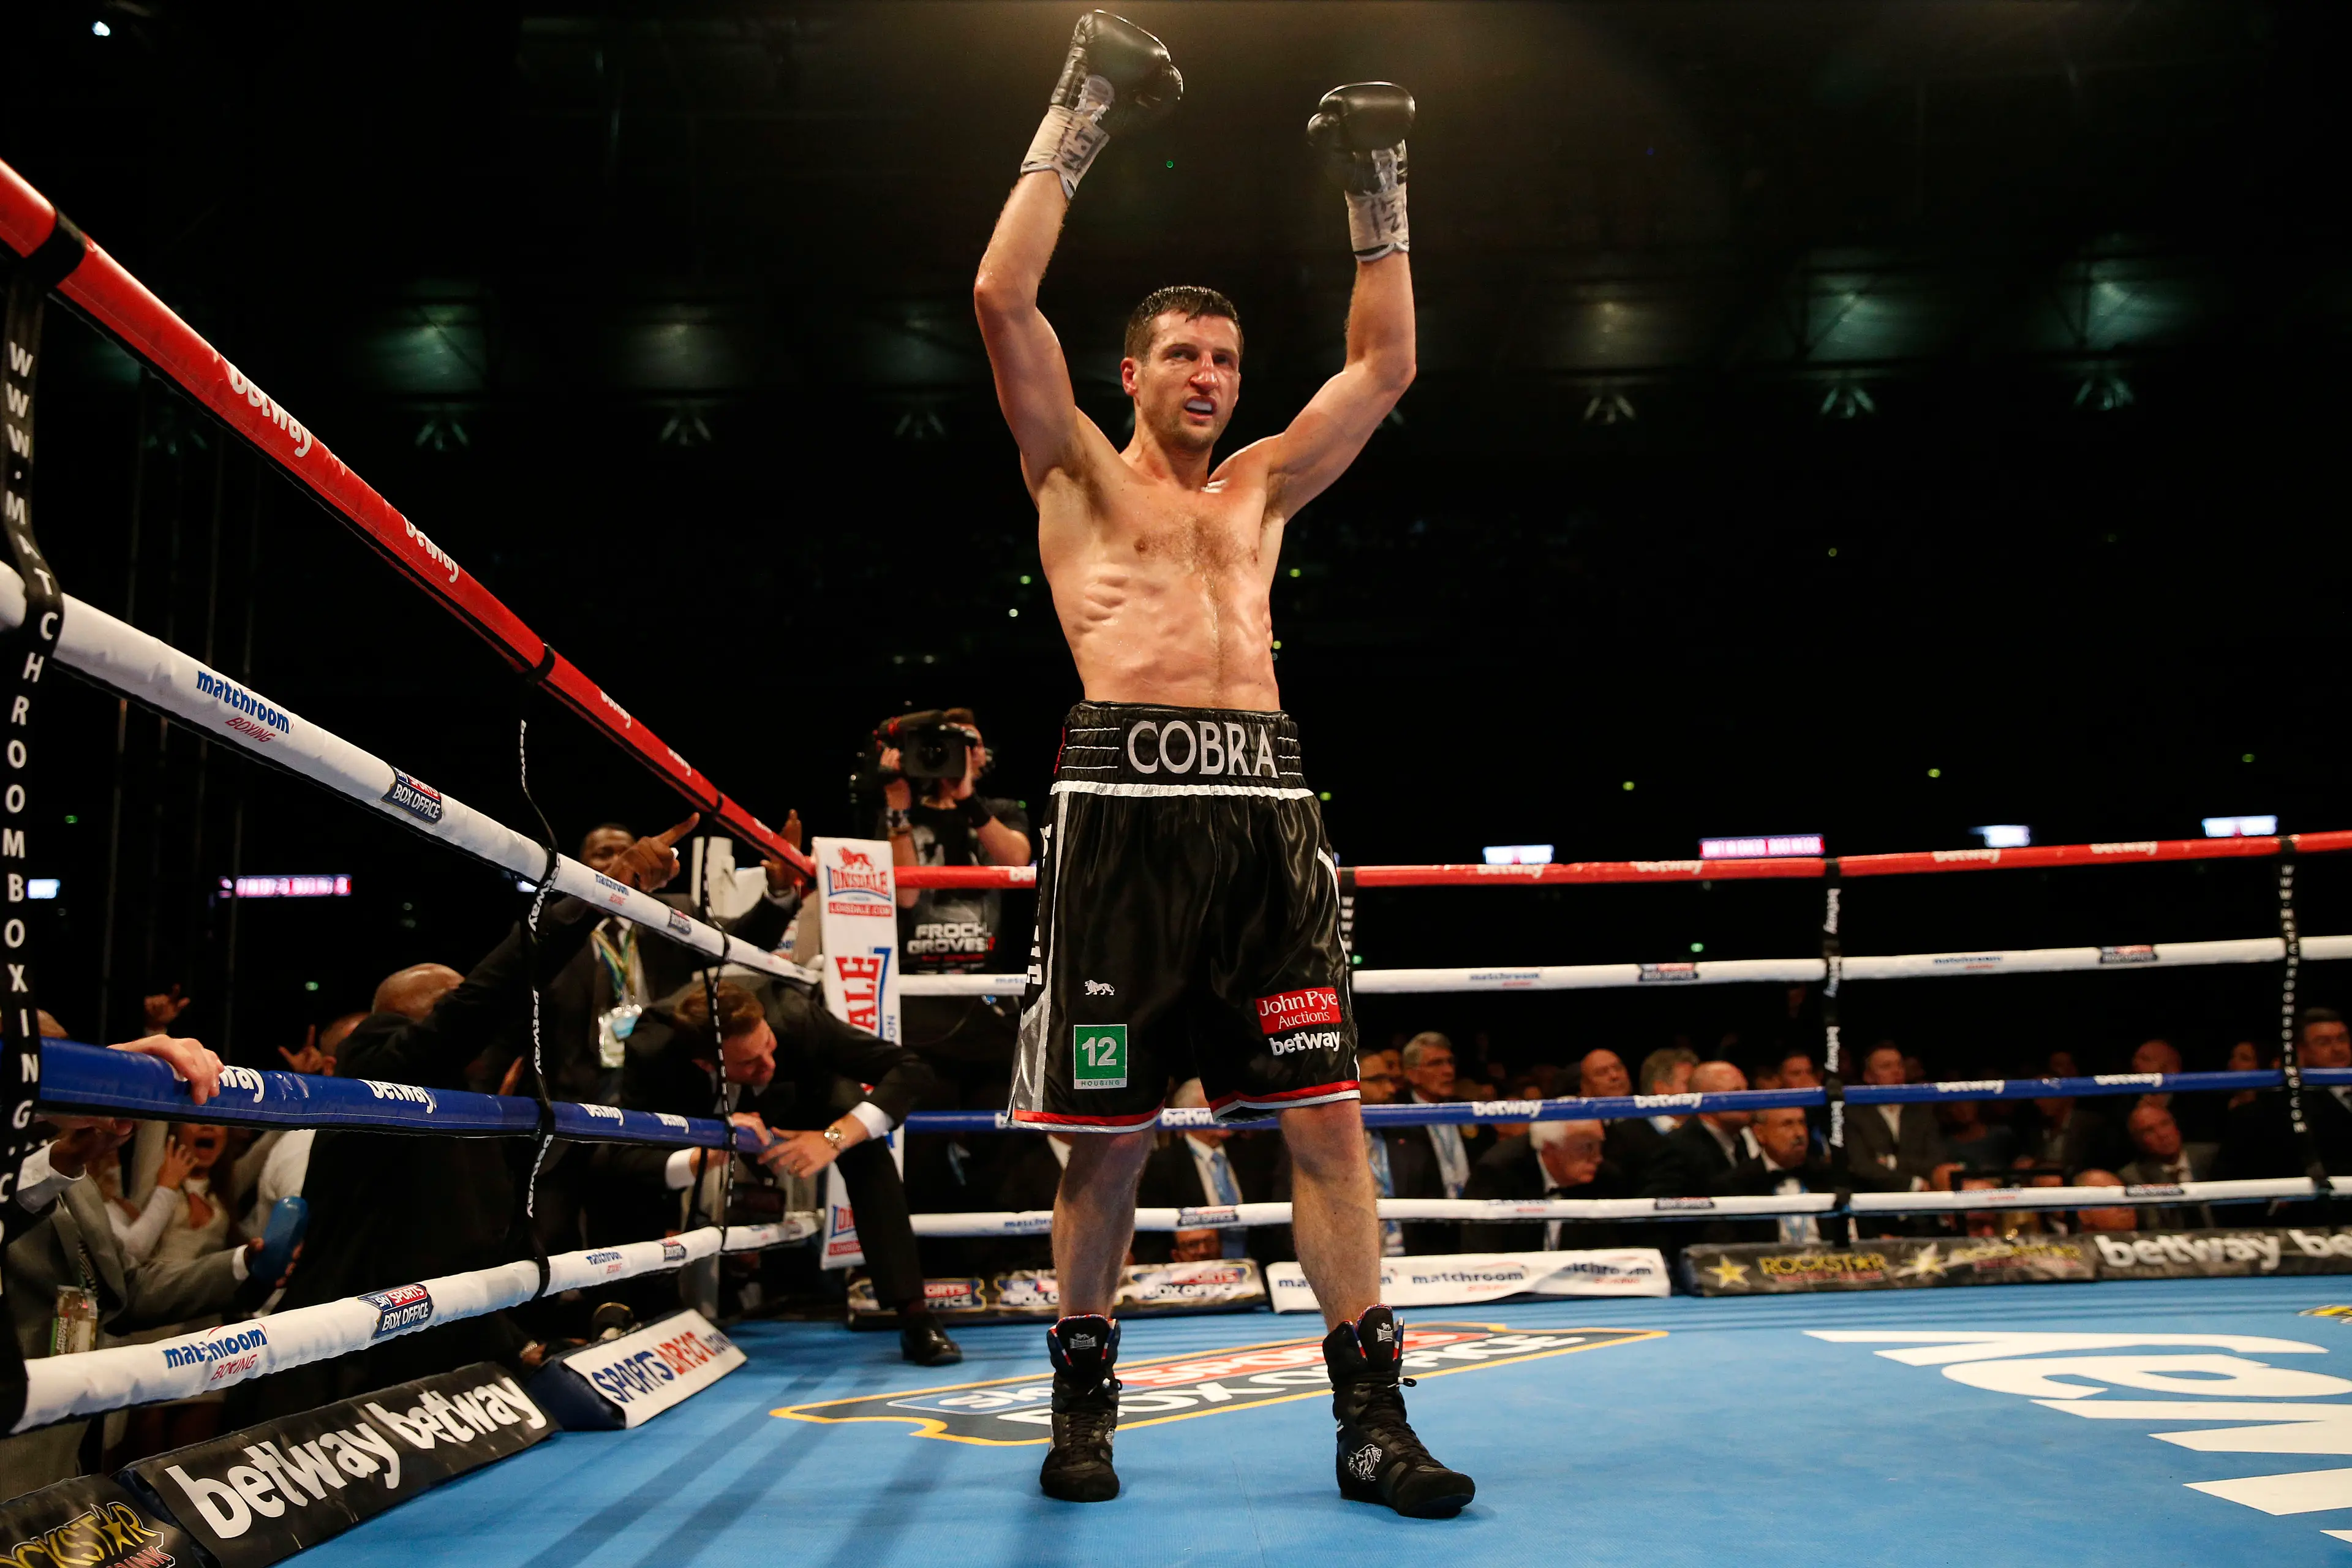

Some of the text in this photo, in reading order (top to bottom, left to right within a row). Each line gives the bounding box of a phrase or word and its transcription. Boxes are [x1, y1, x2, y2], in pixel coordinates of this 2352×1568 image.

[197, 670, 290, 734] matchroom
[225, 717, 276, 742] BOXING
[1127, 720, 1280, 778] COBRA
[393, 783, 441, 819] BOX OFFICE
[826, 865, 892, 902] LONSDALE
[1260, 990, 1338, 1016] John Pye
[1278, 1011, 1330, 1030] Auctions
[1082, 1036, 1117, 1066] 12
[1268, 1031, 1340, 1056] betway
[219, 1065, 265, 1103] way
[358, 1078, 435, 1114] betway
[1161, 1107, 1214, 1127] betw
[1472, 1100, 1543, 1118] betway
[2094, 1234, 2281, 1271] betway
[2287, 1229, 2352, 1258] be
[1412, 1270, 1524, 1284] matchroom
[1758, 1252, 1890, 1276] ROCKSTAR
[374, 1286, 424, 1308] sky SPORTS
[924, 1284, 971, 1297] ORTS
[382, 1302, 429, 1332] BOX OFFICE
[165, 1376, 547, 1539] betway betway
[0, 1504, 158, 1568] CKSTAR
